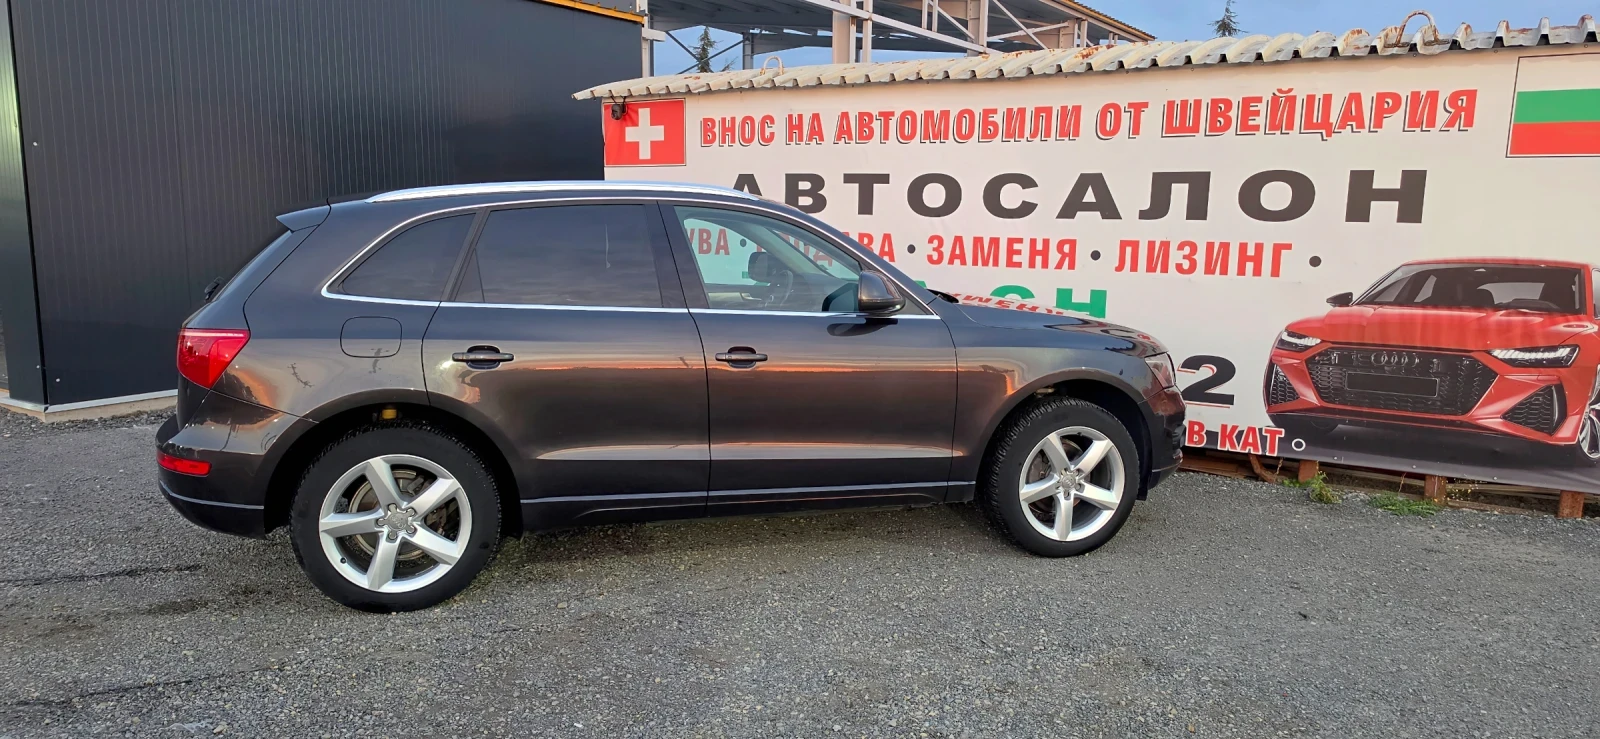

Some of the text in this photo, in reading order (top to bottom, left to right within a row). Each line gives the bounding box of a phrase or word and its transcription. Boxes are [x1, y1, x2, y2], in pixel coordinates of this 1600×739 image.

[700, 87, 1478, 147] ВНОС НА АВТОМОБИЛИ ОТ ШВЕЙЦАРИЯ
[926, 234, 1078, 271] ЗАМЕНЯ
[1114, 239, 1293, 278] ЛИЗИНГ
[1218, 423, 1285, 456] КАТ
